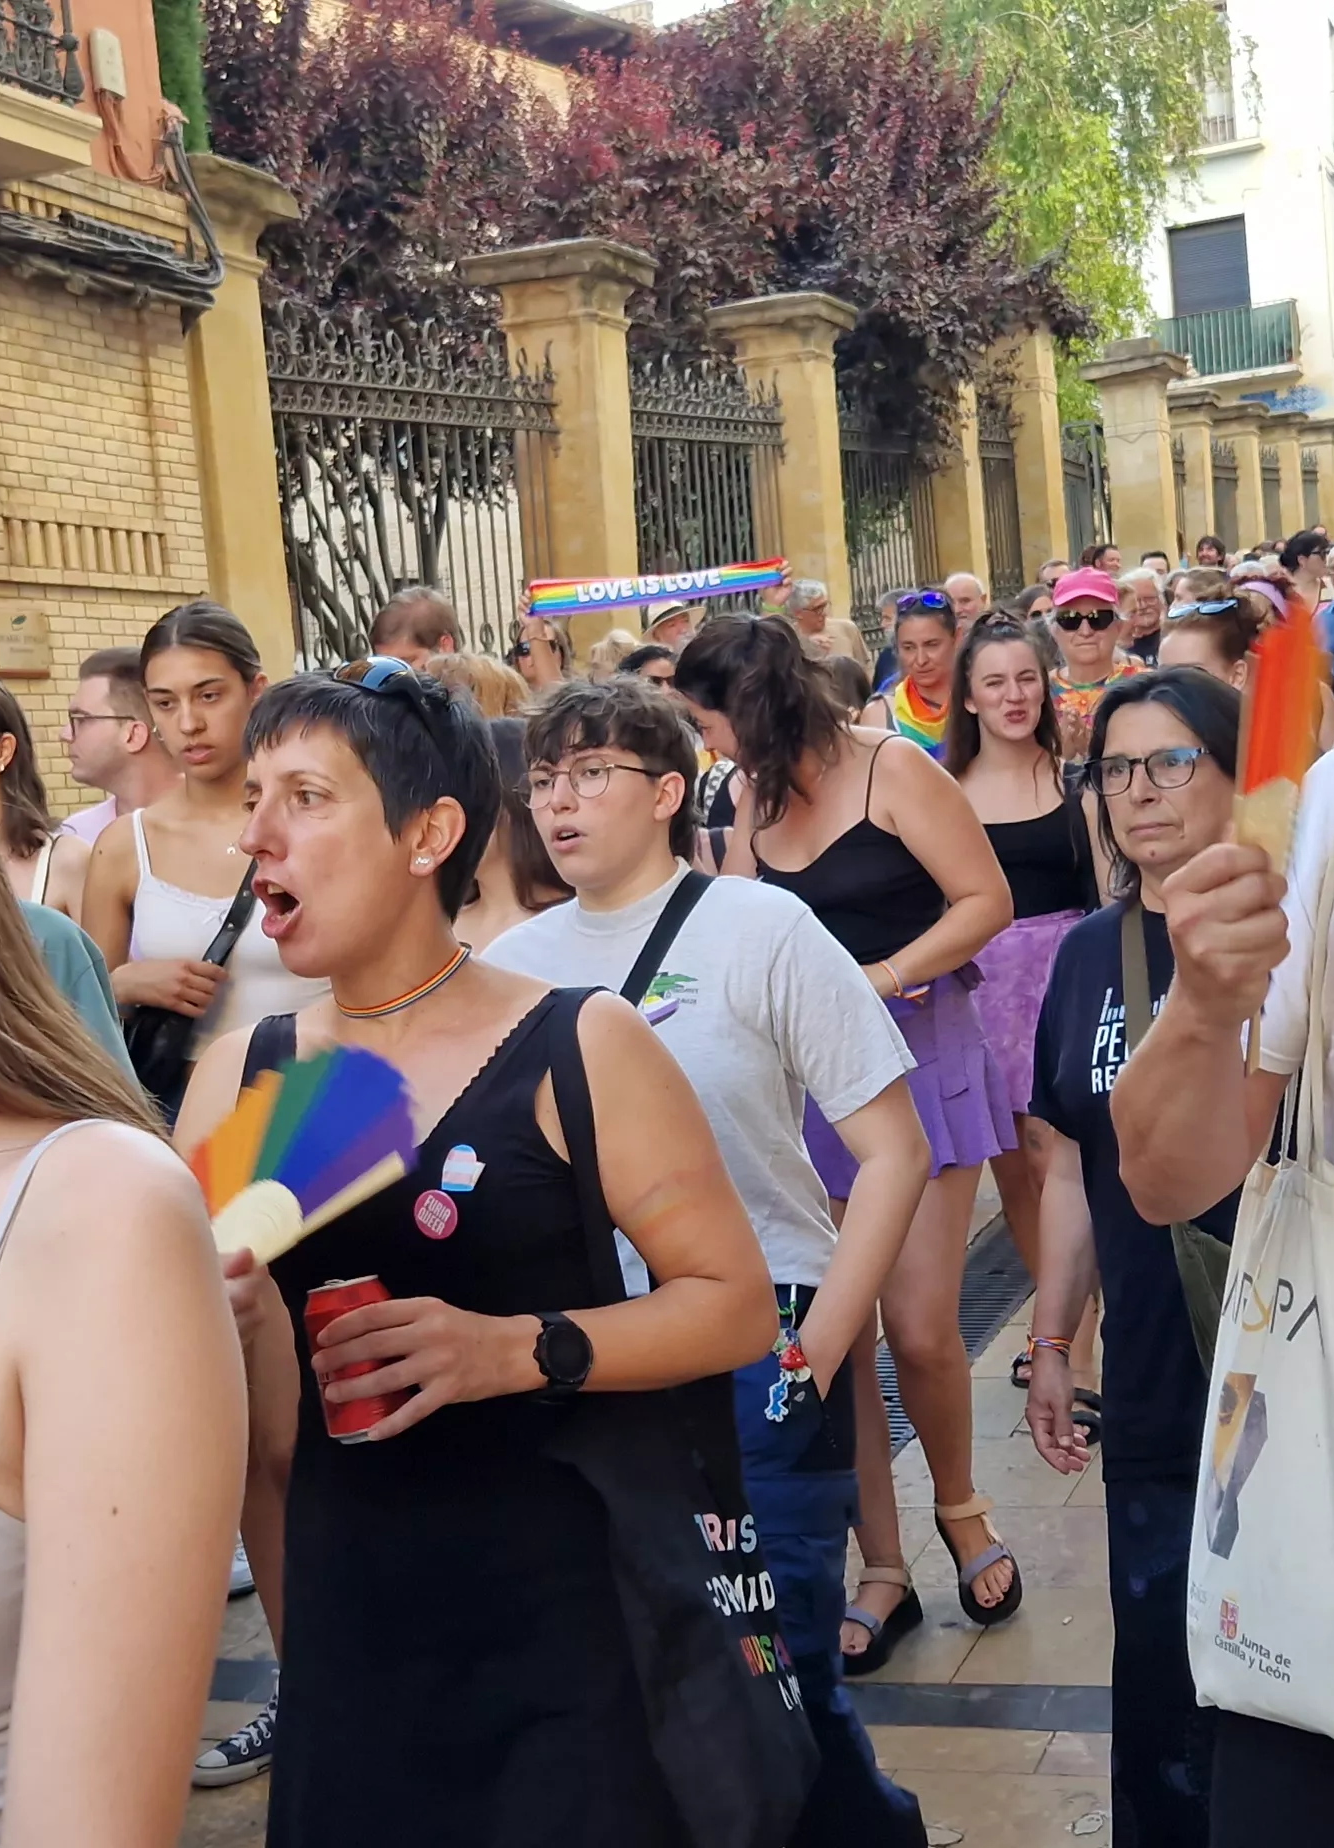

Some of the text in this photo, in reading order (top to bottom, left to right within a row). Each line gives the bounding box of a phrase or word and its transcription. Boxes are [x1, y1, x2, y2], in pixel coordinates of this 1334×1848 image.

[576, 570, 721, 602] LOVE IS LOVE
[418, 1207, 445, 1236] QUEER
[424, 1194, 451, 1222] FURIA
[1214, 1634, 1290, 1683] Castilla y León
[1239, 1633, 1291, 1668] Junta de
